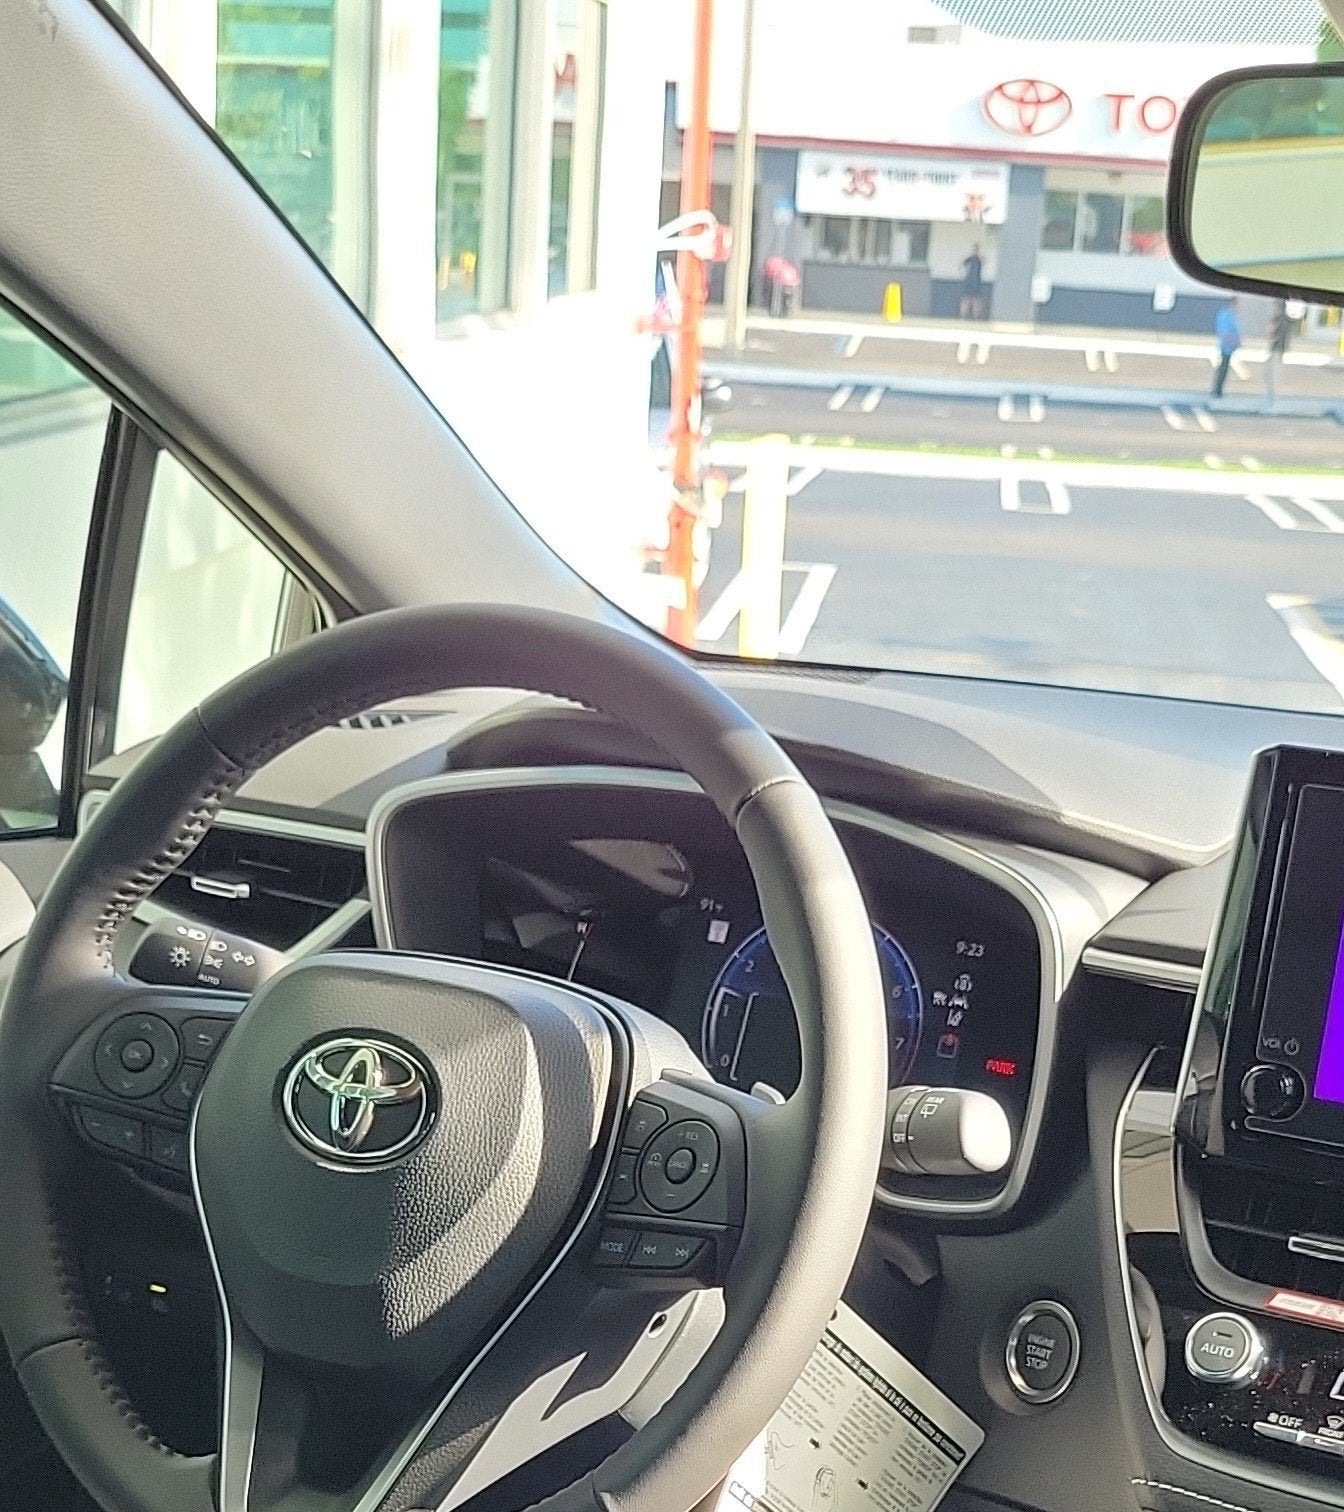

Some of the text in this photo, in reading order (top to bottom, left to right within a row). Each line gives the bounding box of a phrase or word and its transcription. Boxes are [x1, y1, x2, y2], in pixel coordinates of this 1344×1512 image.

[1103, 92, 1178, 132] TO
[1200, 1342, 1234, 1359] AUTO
[1278, 1414, 1304, 1429] OFF
